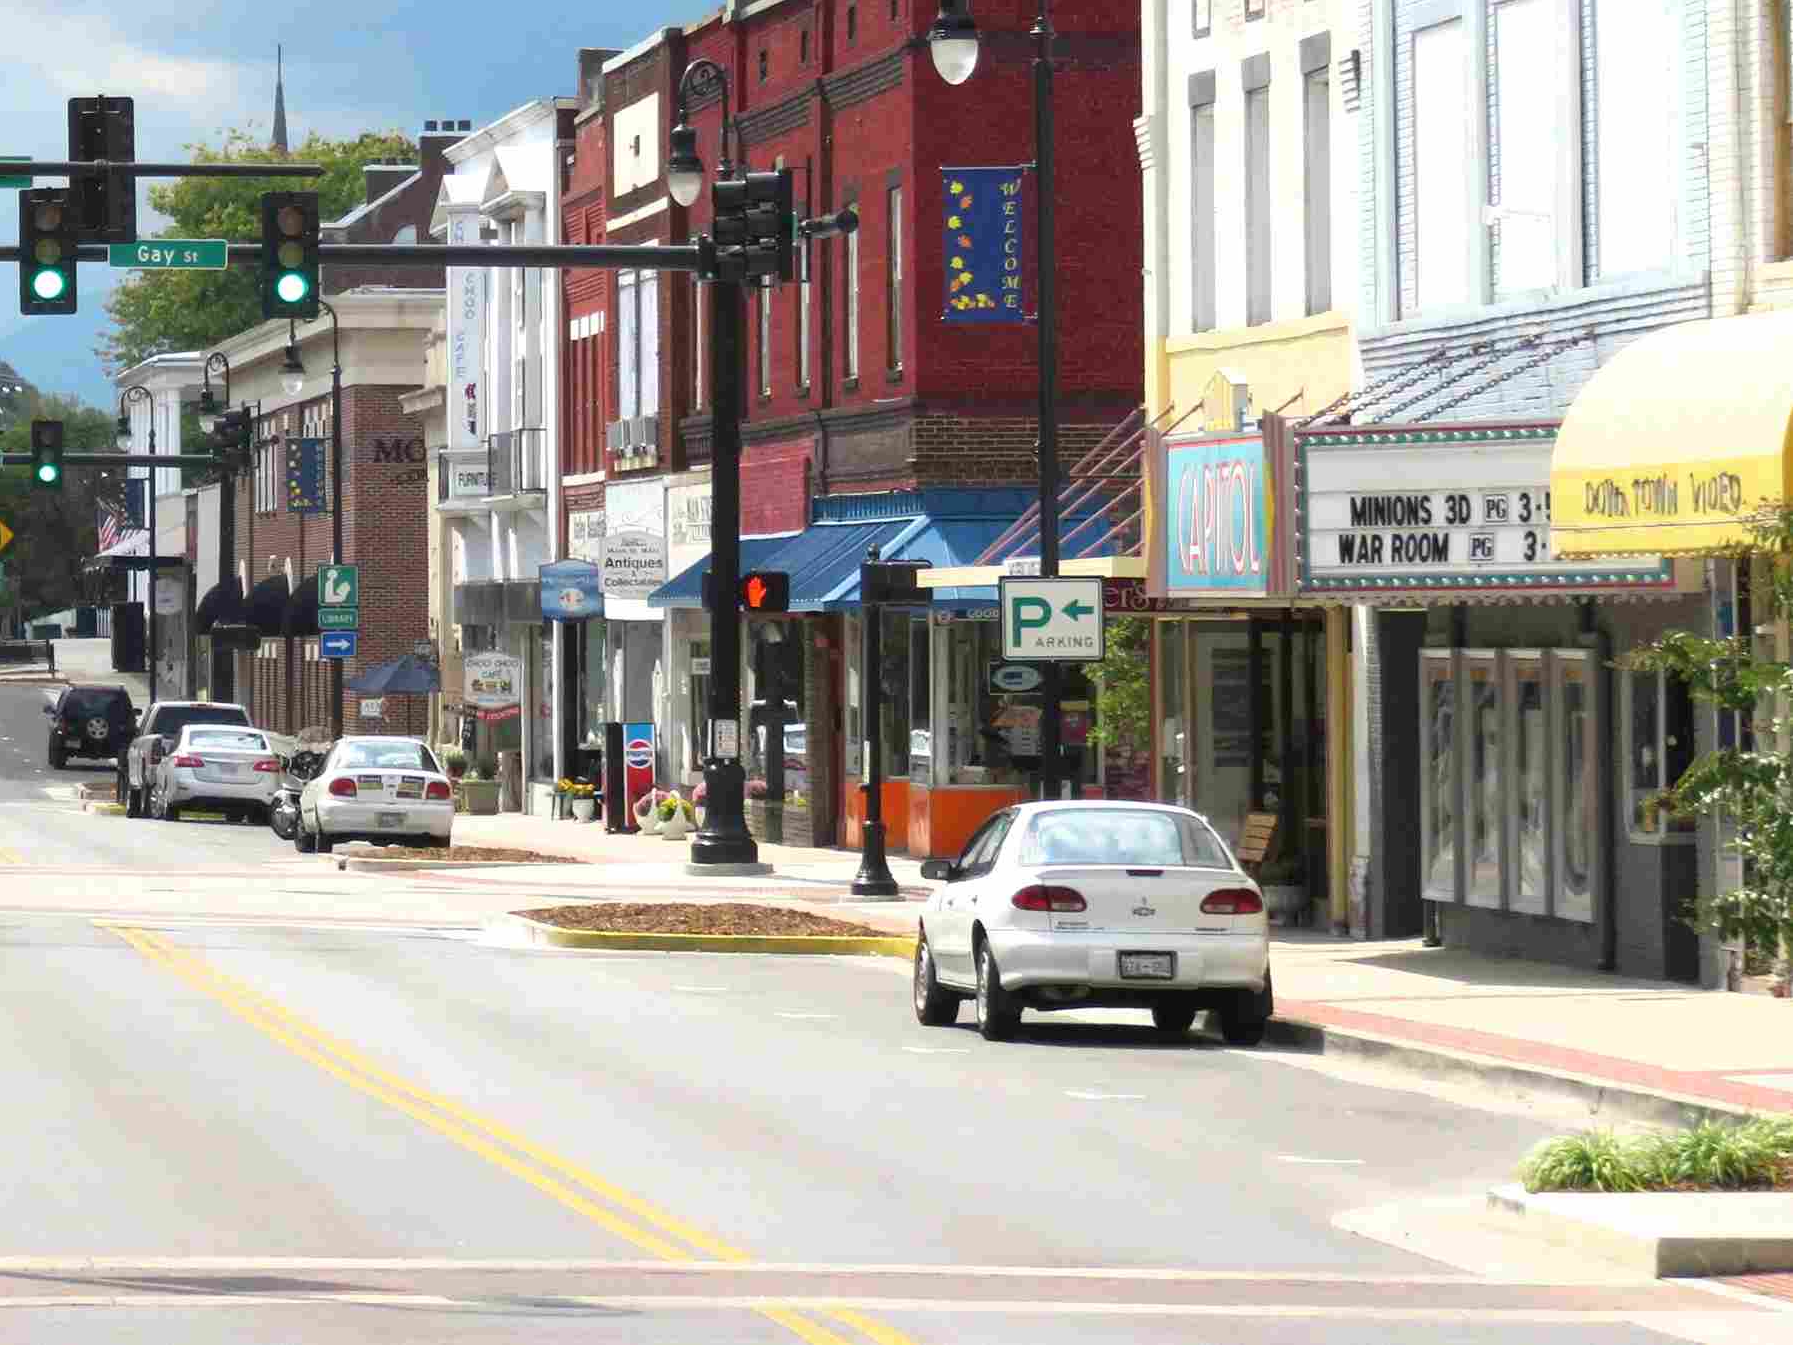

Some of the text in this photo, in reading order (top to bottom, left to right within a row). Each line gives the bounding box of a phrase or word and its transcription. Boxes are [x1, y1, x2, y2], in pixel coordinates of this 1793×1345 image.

[137, 245, 175, 266] Gay
[999, 180, 1022, 308] WELCOME
[1178, 459, 1262, 575] CAPITOL
[1350, 494, 1432, 526] MINIONS
[1445, 494, 1471, 525] 3D
[1485, 498, 1507, 519] PG
[1338, 533, 1383, 563] WAR
[1391, 532, 1450, 563] ROOM
[1471, 537, 1494, 557] PG
[605, 557, 663, 572] Antiques
